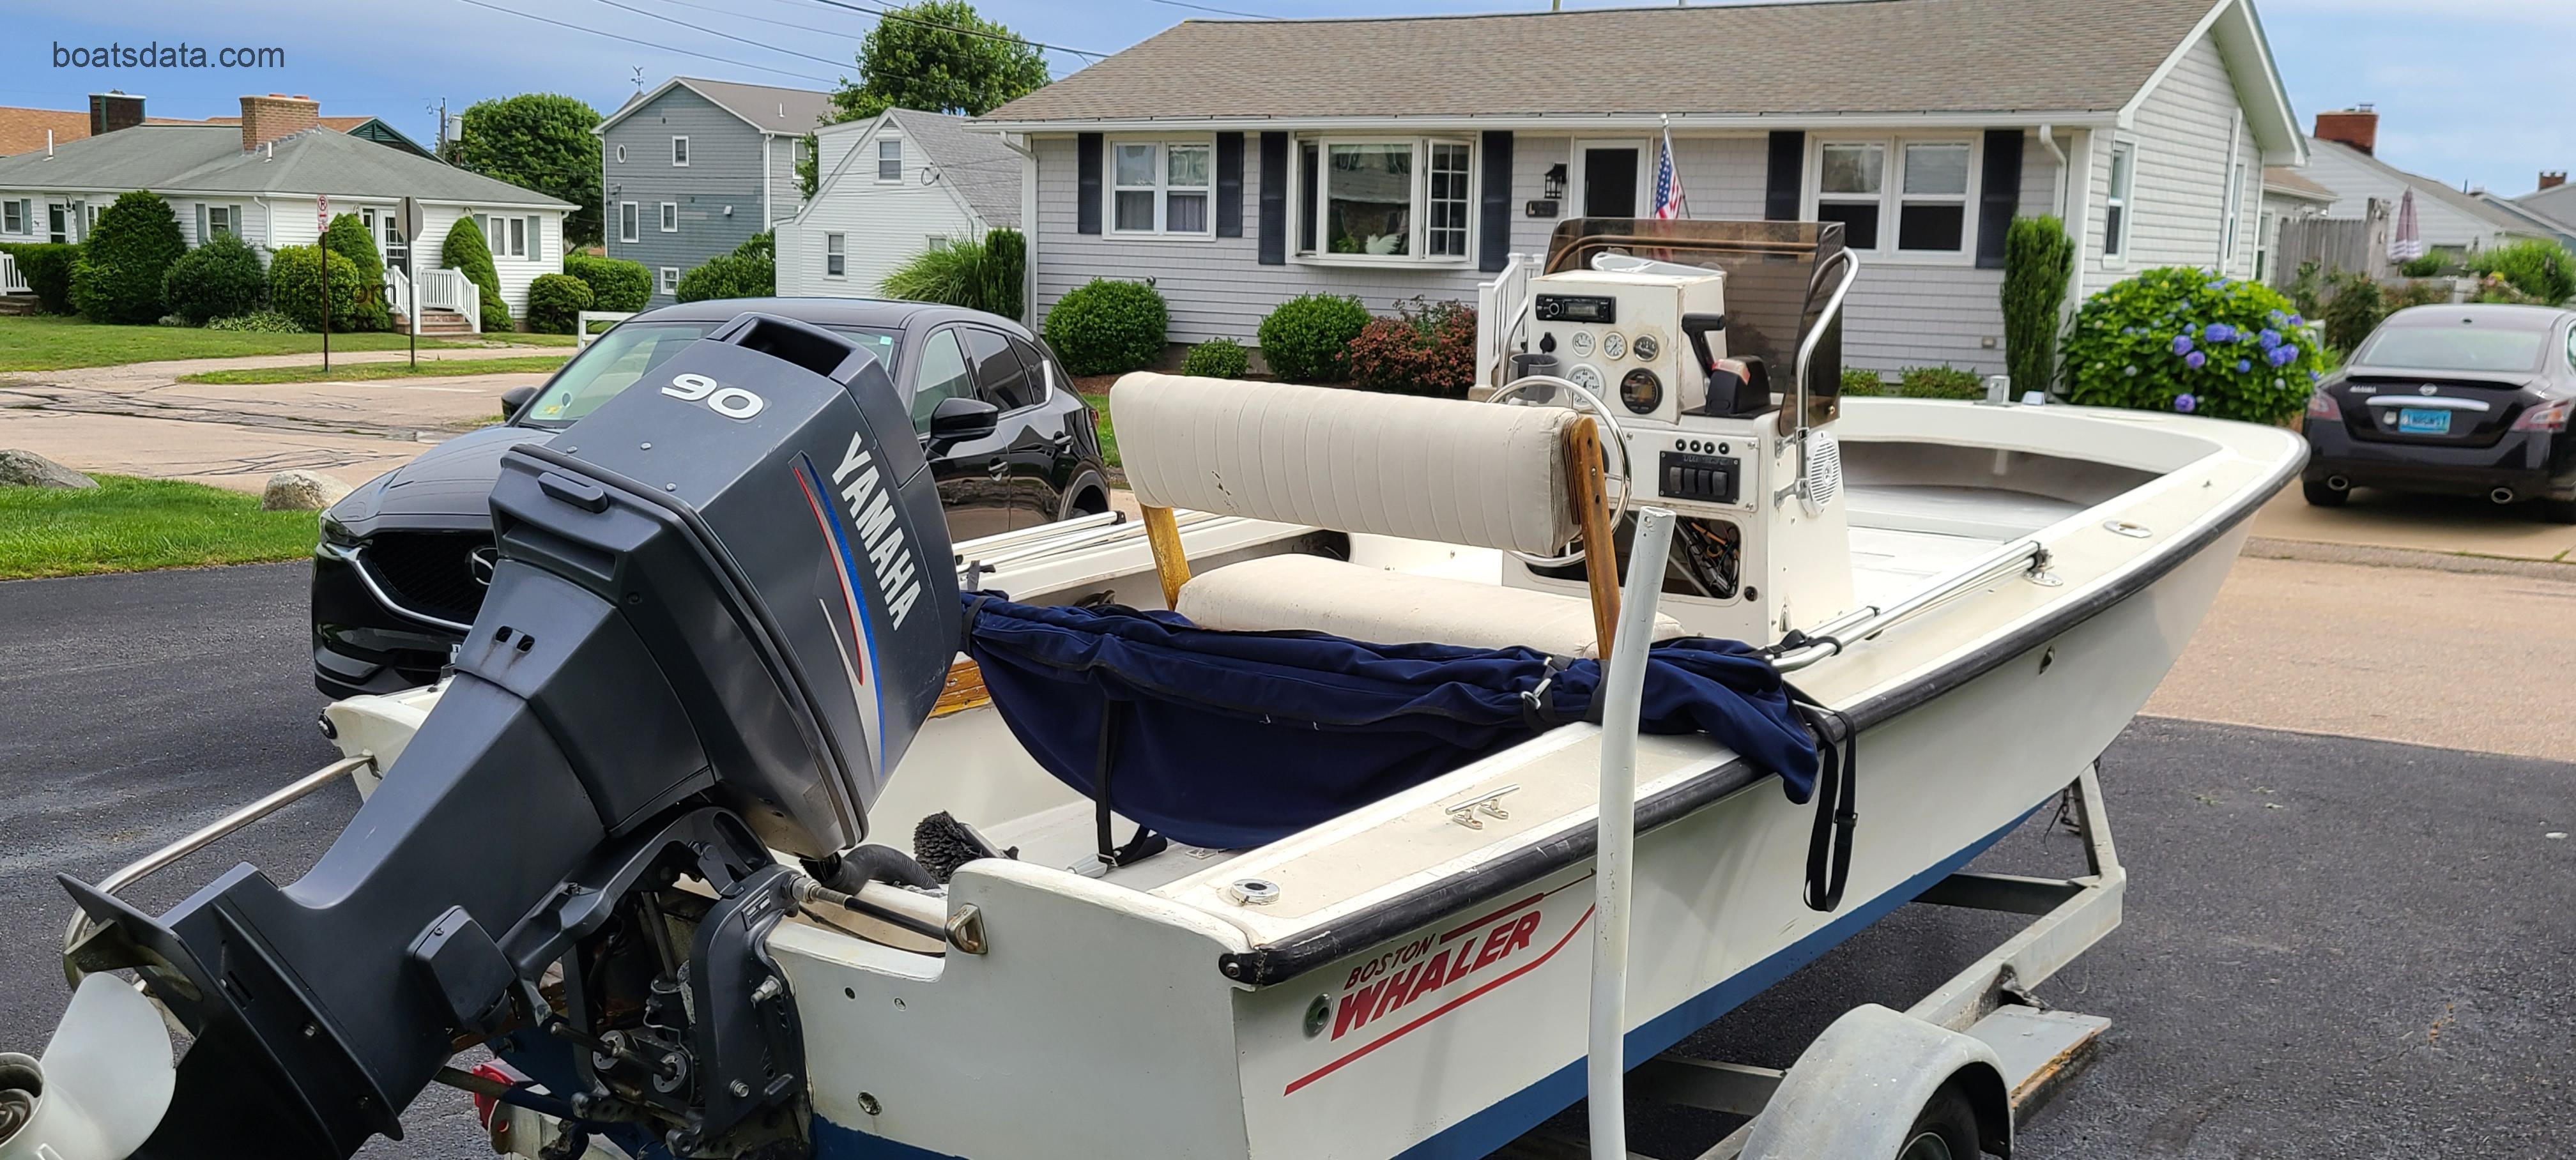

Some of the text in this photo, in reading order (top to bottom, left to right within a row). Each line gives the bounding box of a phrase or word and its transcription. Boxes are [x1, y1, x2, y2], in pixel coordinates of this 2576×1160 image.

[661, 373, 764, 420] 90
[832, 431, 922, 631] YAMAHA
[1331, 910, 1541, 1041] WHALER
[1344, 933, 1436, 990] BOSTON
